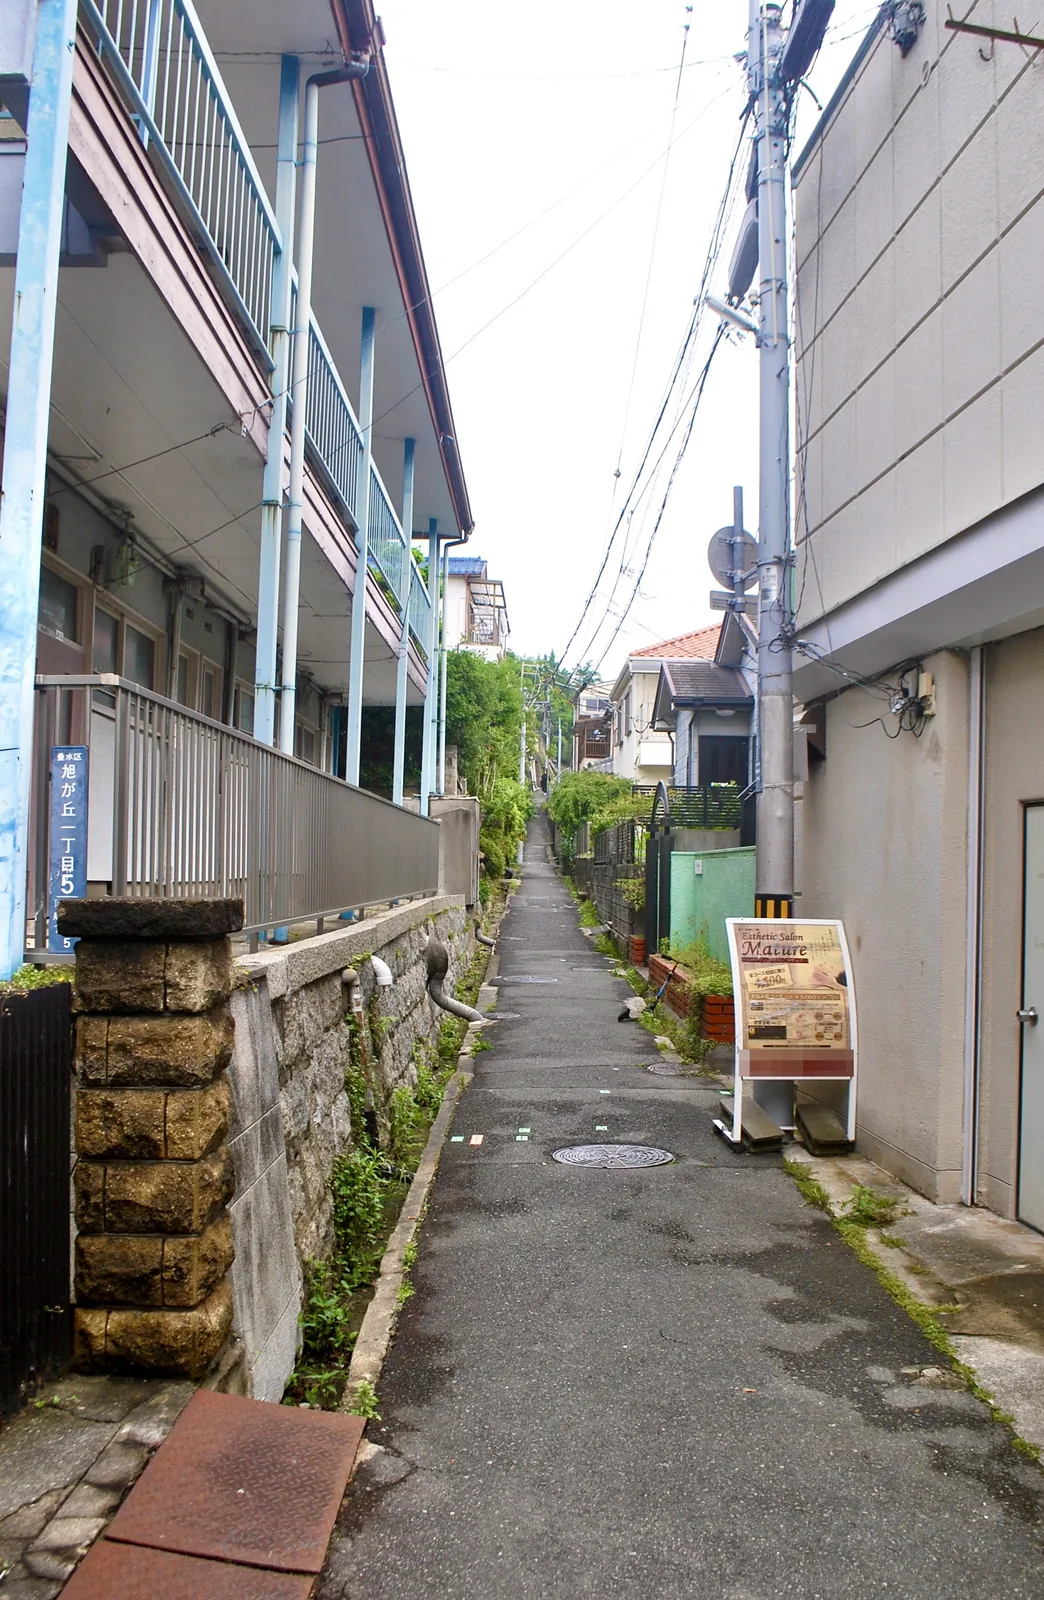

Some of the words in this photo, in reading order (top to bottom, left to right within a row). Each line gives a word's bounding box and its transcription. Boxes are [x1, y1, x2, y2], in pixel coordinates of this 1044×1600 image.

[741, 931, 777, 941] Esthetic
[778, 932, 804, 941] Salon
[63, 937, 71, 949] 5
[741, 941, 808, 957] Mature
